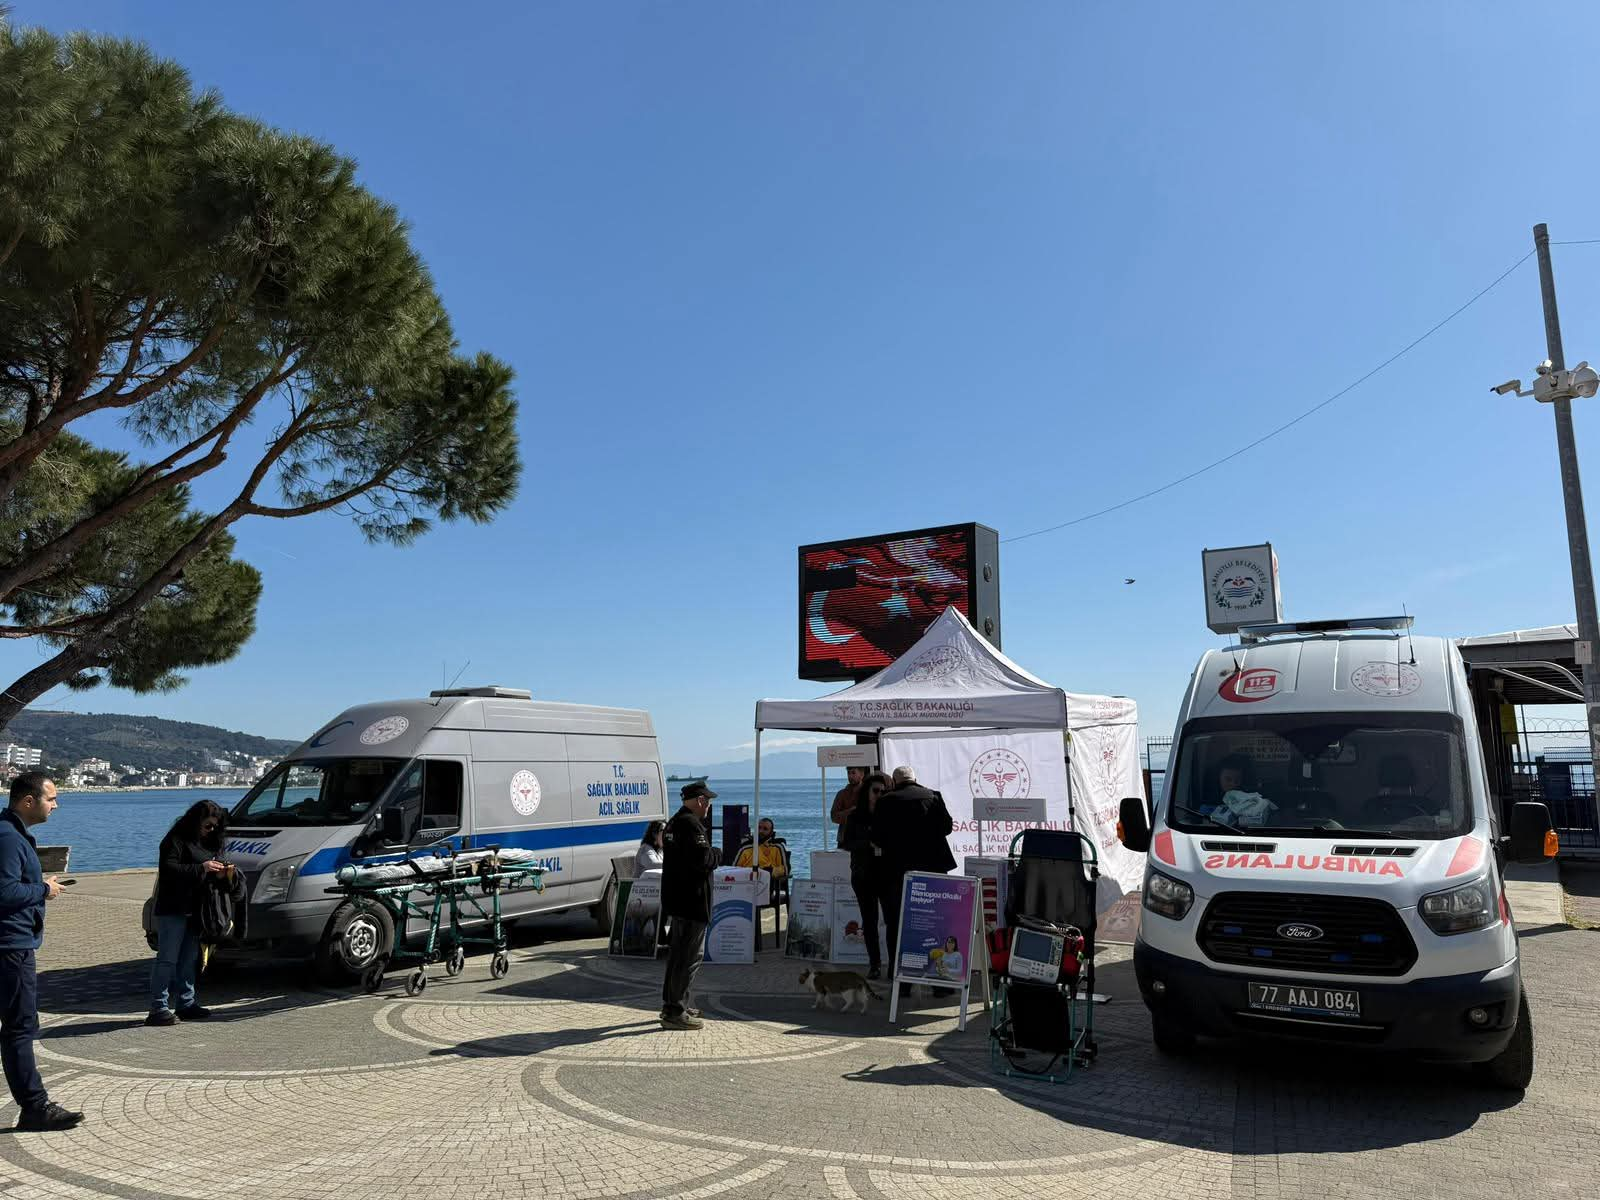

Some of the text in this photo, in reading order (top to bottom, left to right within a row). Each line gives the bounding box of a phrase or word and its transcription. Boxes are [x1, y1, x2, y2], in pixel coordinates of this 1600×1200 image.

[1248, 677, 1272, 687] 112
[915, 701, 975, 712] BAKANLIĞI
[859, 711, 885, 719] YALOVA
[613, 764, 626, 778] T.C.
[587, 779, 650, 797] SAĞLIK BAKANLIĞI
[599, 798, 641, 816] ACİL SAĞLIK
[985, 834, 1020, 842] YALOV
[535, 856, 563, 872] AKİL
[1286, 925, 1313, 938] Ford
[1260, 986, 1278, 1003] 77
[1288, 988, 1318, 1007] AAJ
[1324, 991, 1355, 1010] 084
